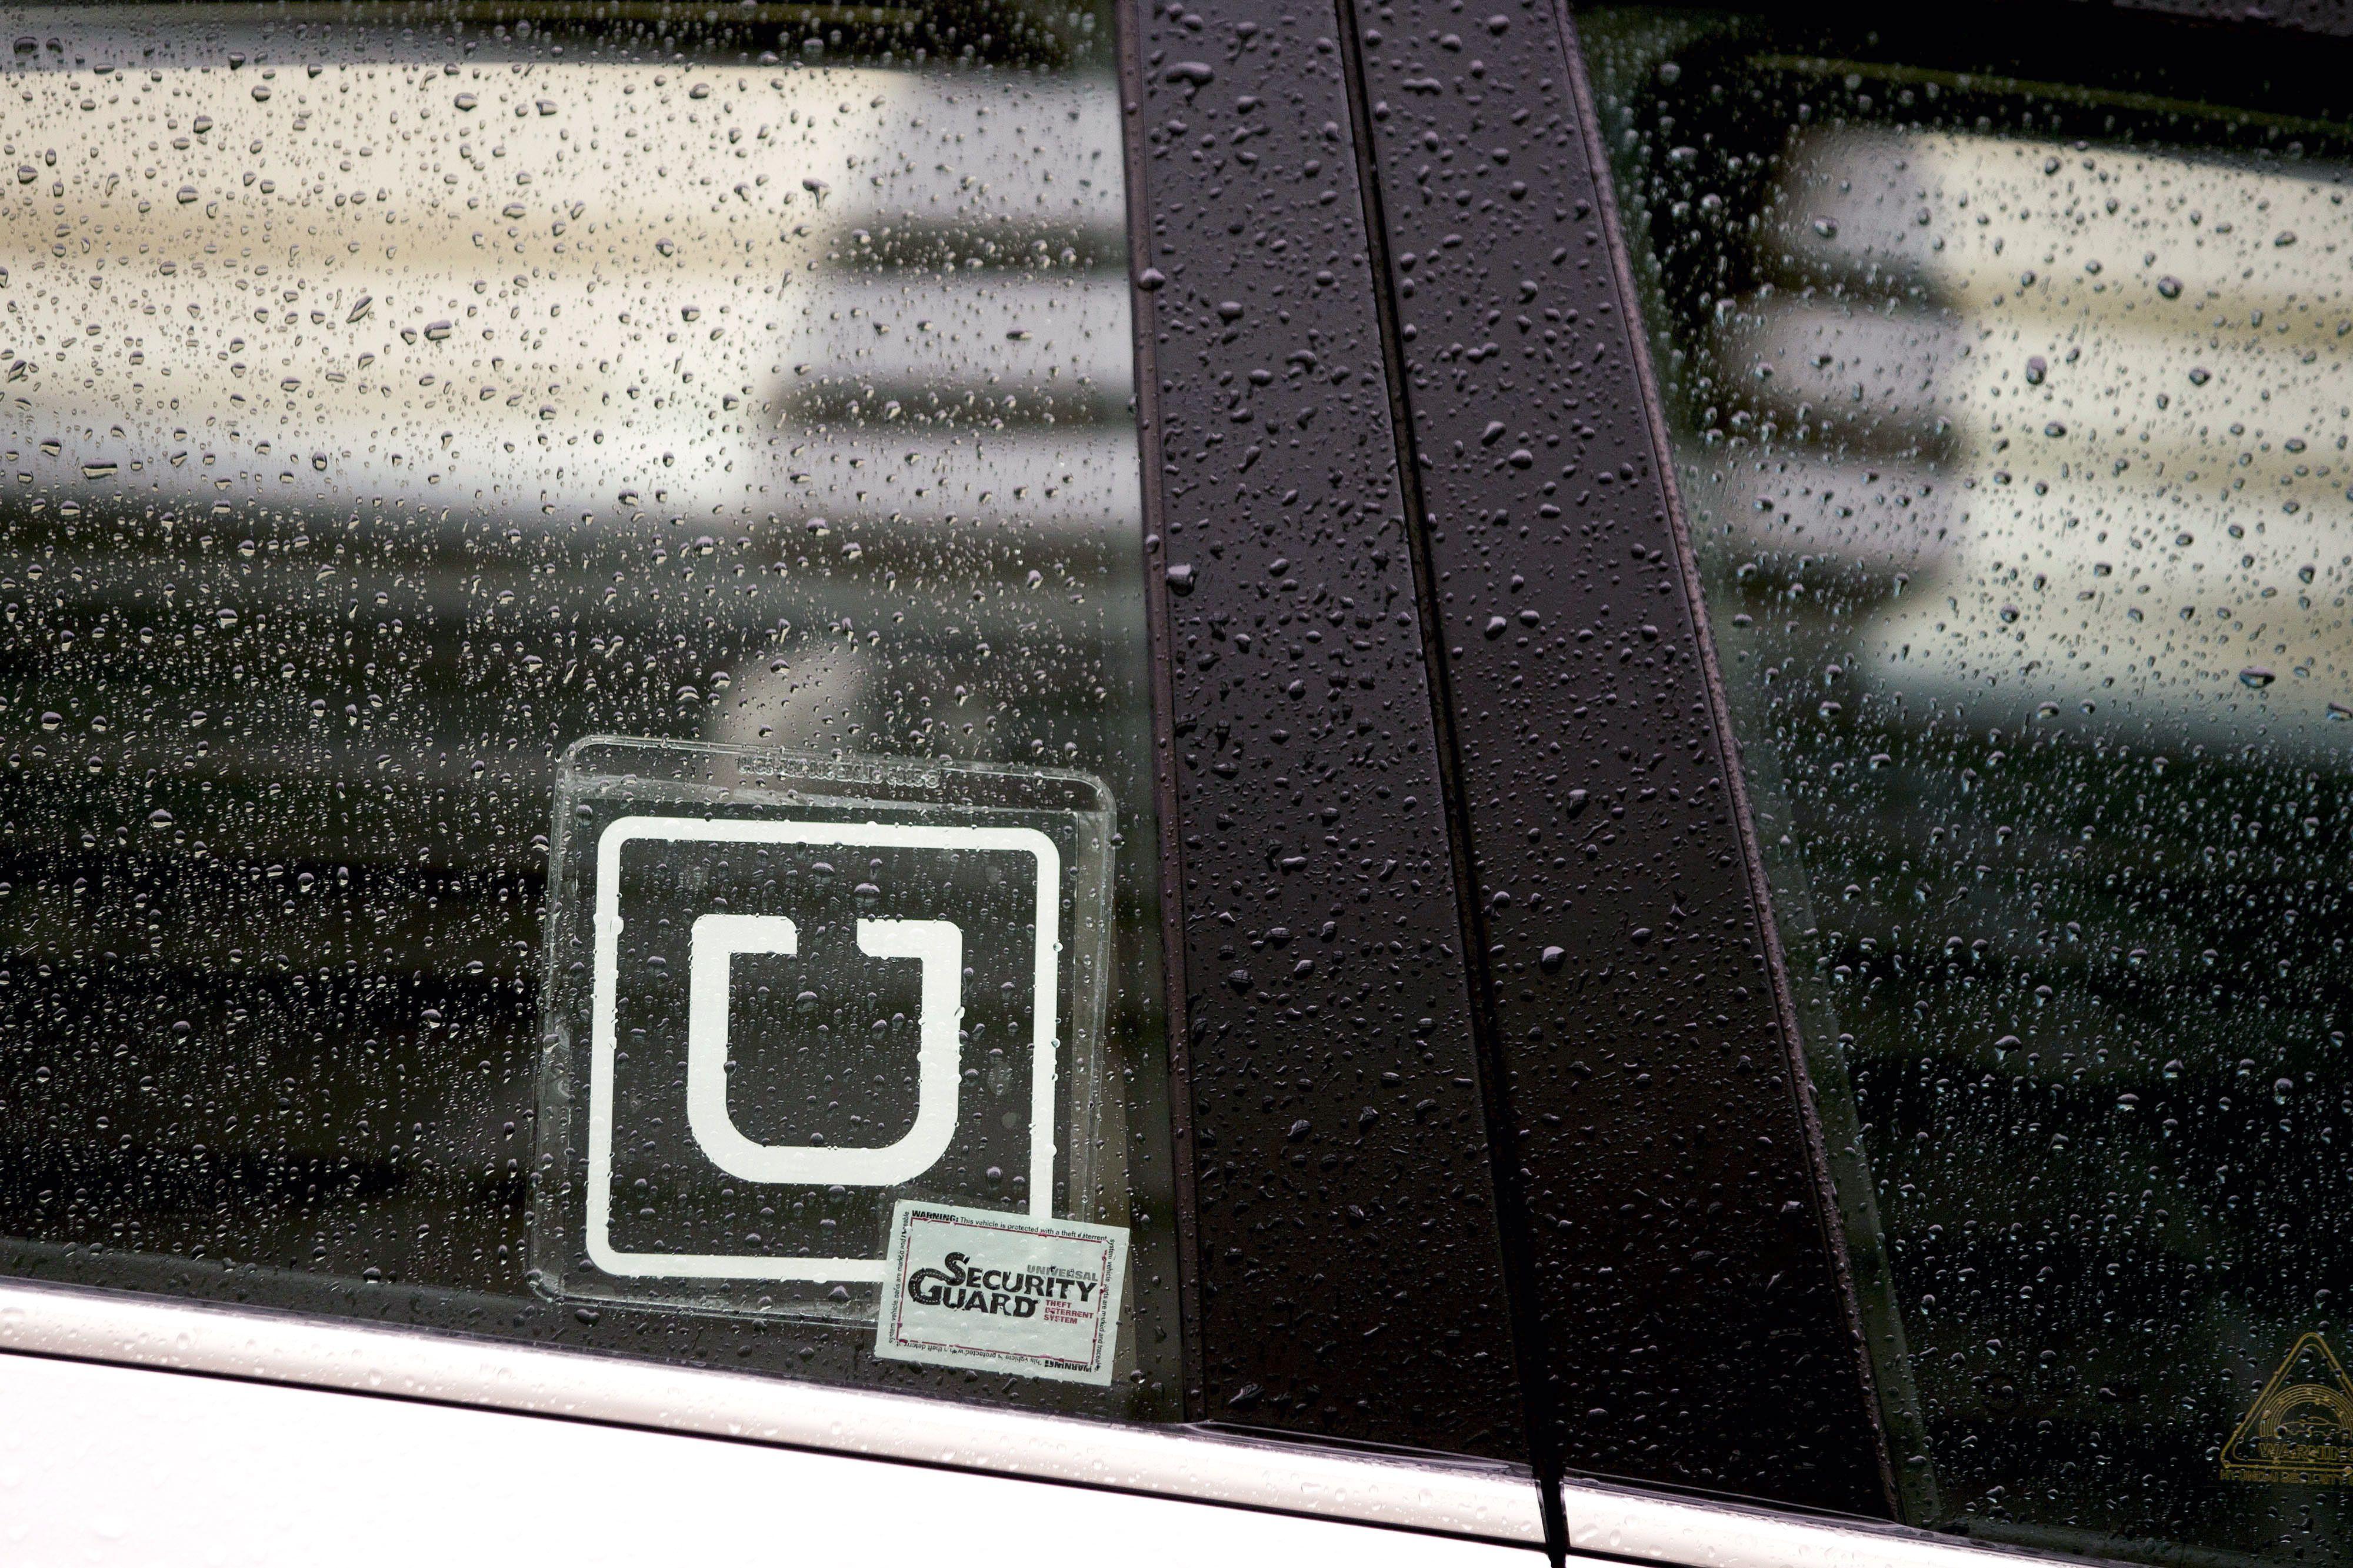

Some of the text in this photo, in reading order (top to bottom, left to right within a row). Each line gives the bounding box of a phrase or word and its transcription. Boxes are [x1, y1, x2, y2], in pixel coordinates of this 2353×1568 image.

[912, 1210, 958, 1222] WARNING:
[961, 1216, 974, 1225] This
[975, 1219, 998, 1227] vehicle
[1007, 1224, 1038, 1233] protected
[944, 1252, 1097, 1302] SECURITY
[1026, 1265, 1098, 1282] UNIVERSAL
[1105, 1262, 1114, 1282] vehicle
[908, 1267, 1036, 1318] GUARD
[1046, 1299, 1072, 1309] THEFT
[1044, 1315, 1078, 1325] SYSTEM
[1045, 1307, 1094, 1319] DETERRENT
[965, 1349, 996, 1359] protected
[2221, 1469, 2279, 1482] HYUNDAI
[2281, 1472, 2344, 1485] SEURITY
